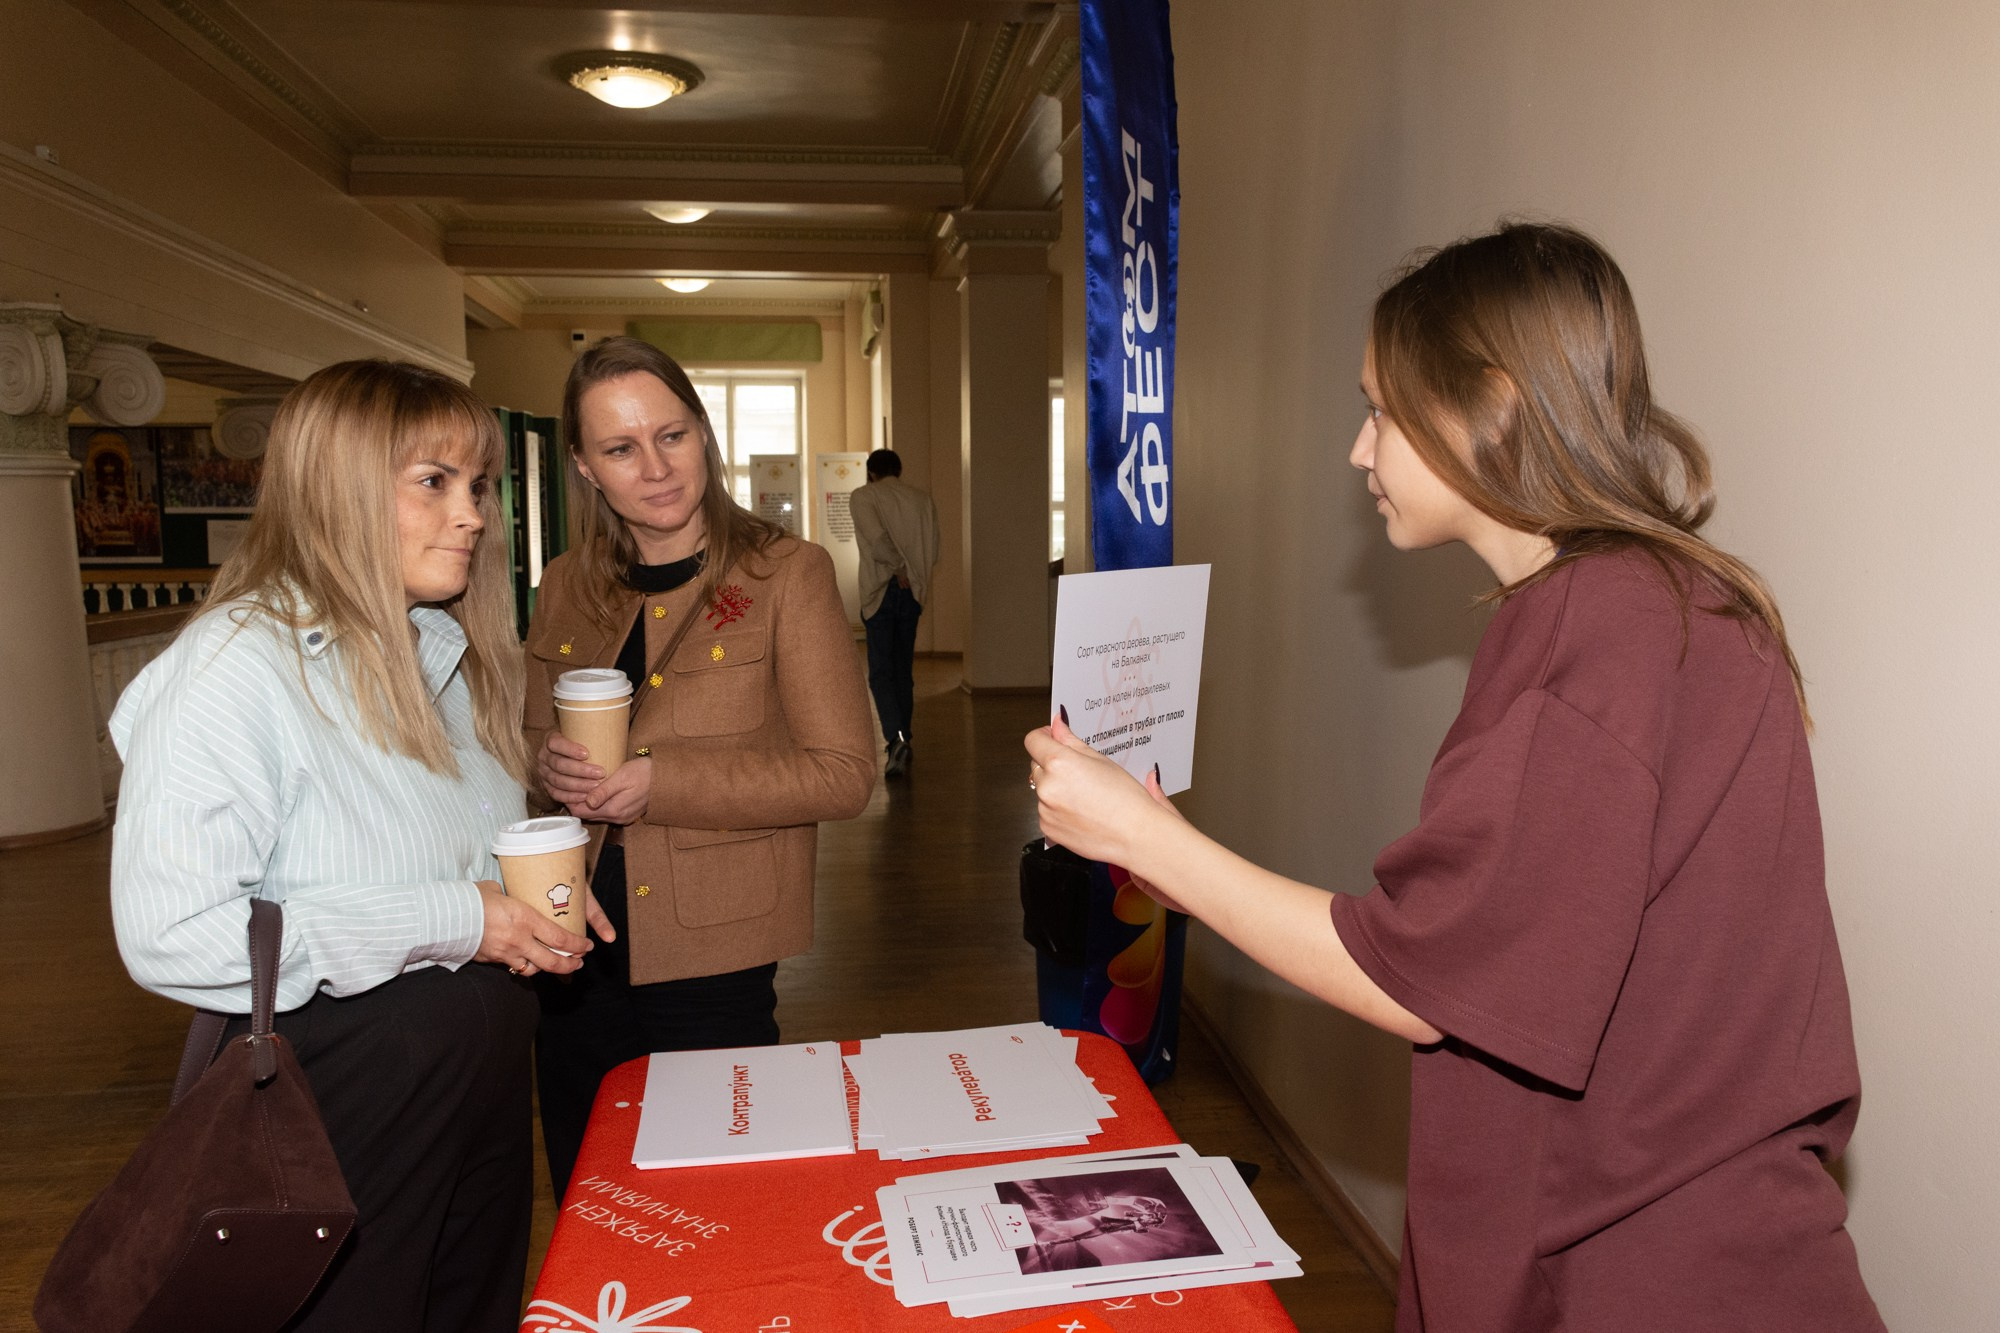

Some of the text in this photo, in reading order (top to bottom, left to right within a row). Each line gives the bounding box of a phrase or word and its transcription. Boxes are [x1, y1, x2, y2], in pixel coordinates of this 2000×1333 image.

[1135, 142, 1169, 526] ФЕСТ
[1077, 631, 1186, 659] Сорт красного дерева, растущего
[1111, 653, 1151, 669] на Балканах
[1084, 681, 1171, 711] Одно из колен Израилевых
[1092, 724, 1128, 744] отложения
[1134, 716, 1156, 731] трубах
[1157, 714, 1165, 723] от
[1166, 709, 1185, 721] плохо
[1134, 734, 1152, 747] воды
[578, 1176, 730, 1239] ЗНАНИЯМИ
[566, 1200, 696, 1257] ЗАРЯЖЕН
[907, 1217, 924, 1256] РОБЕРТ ЗЕМЕКИС
